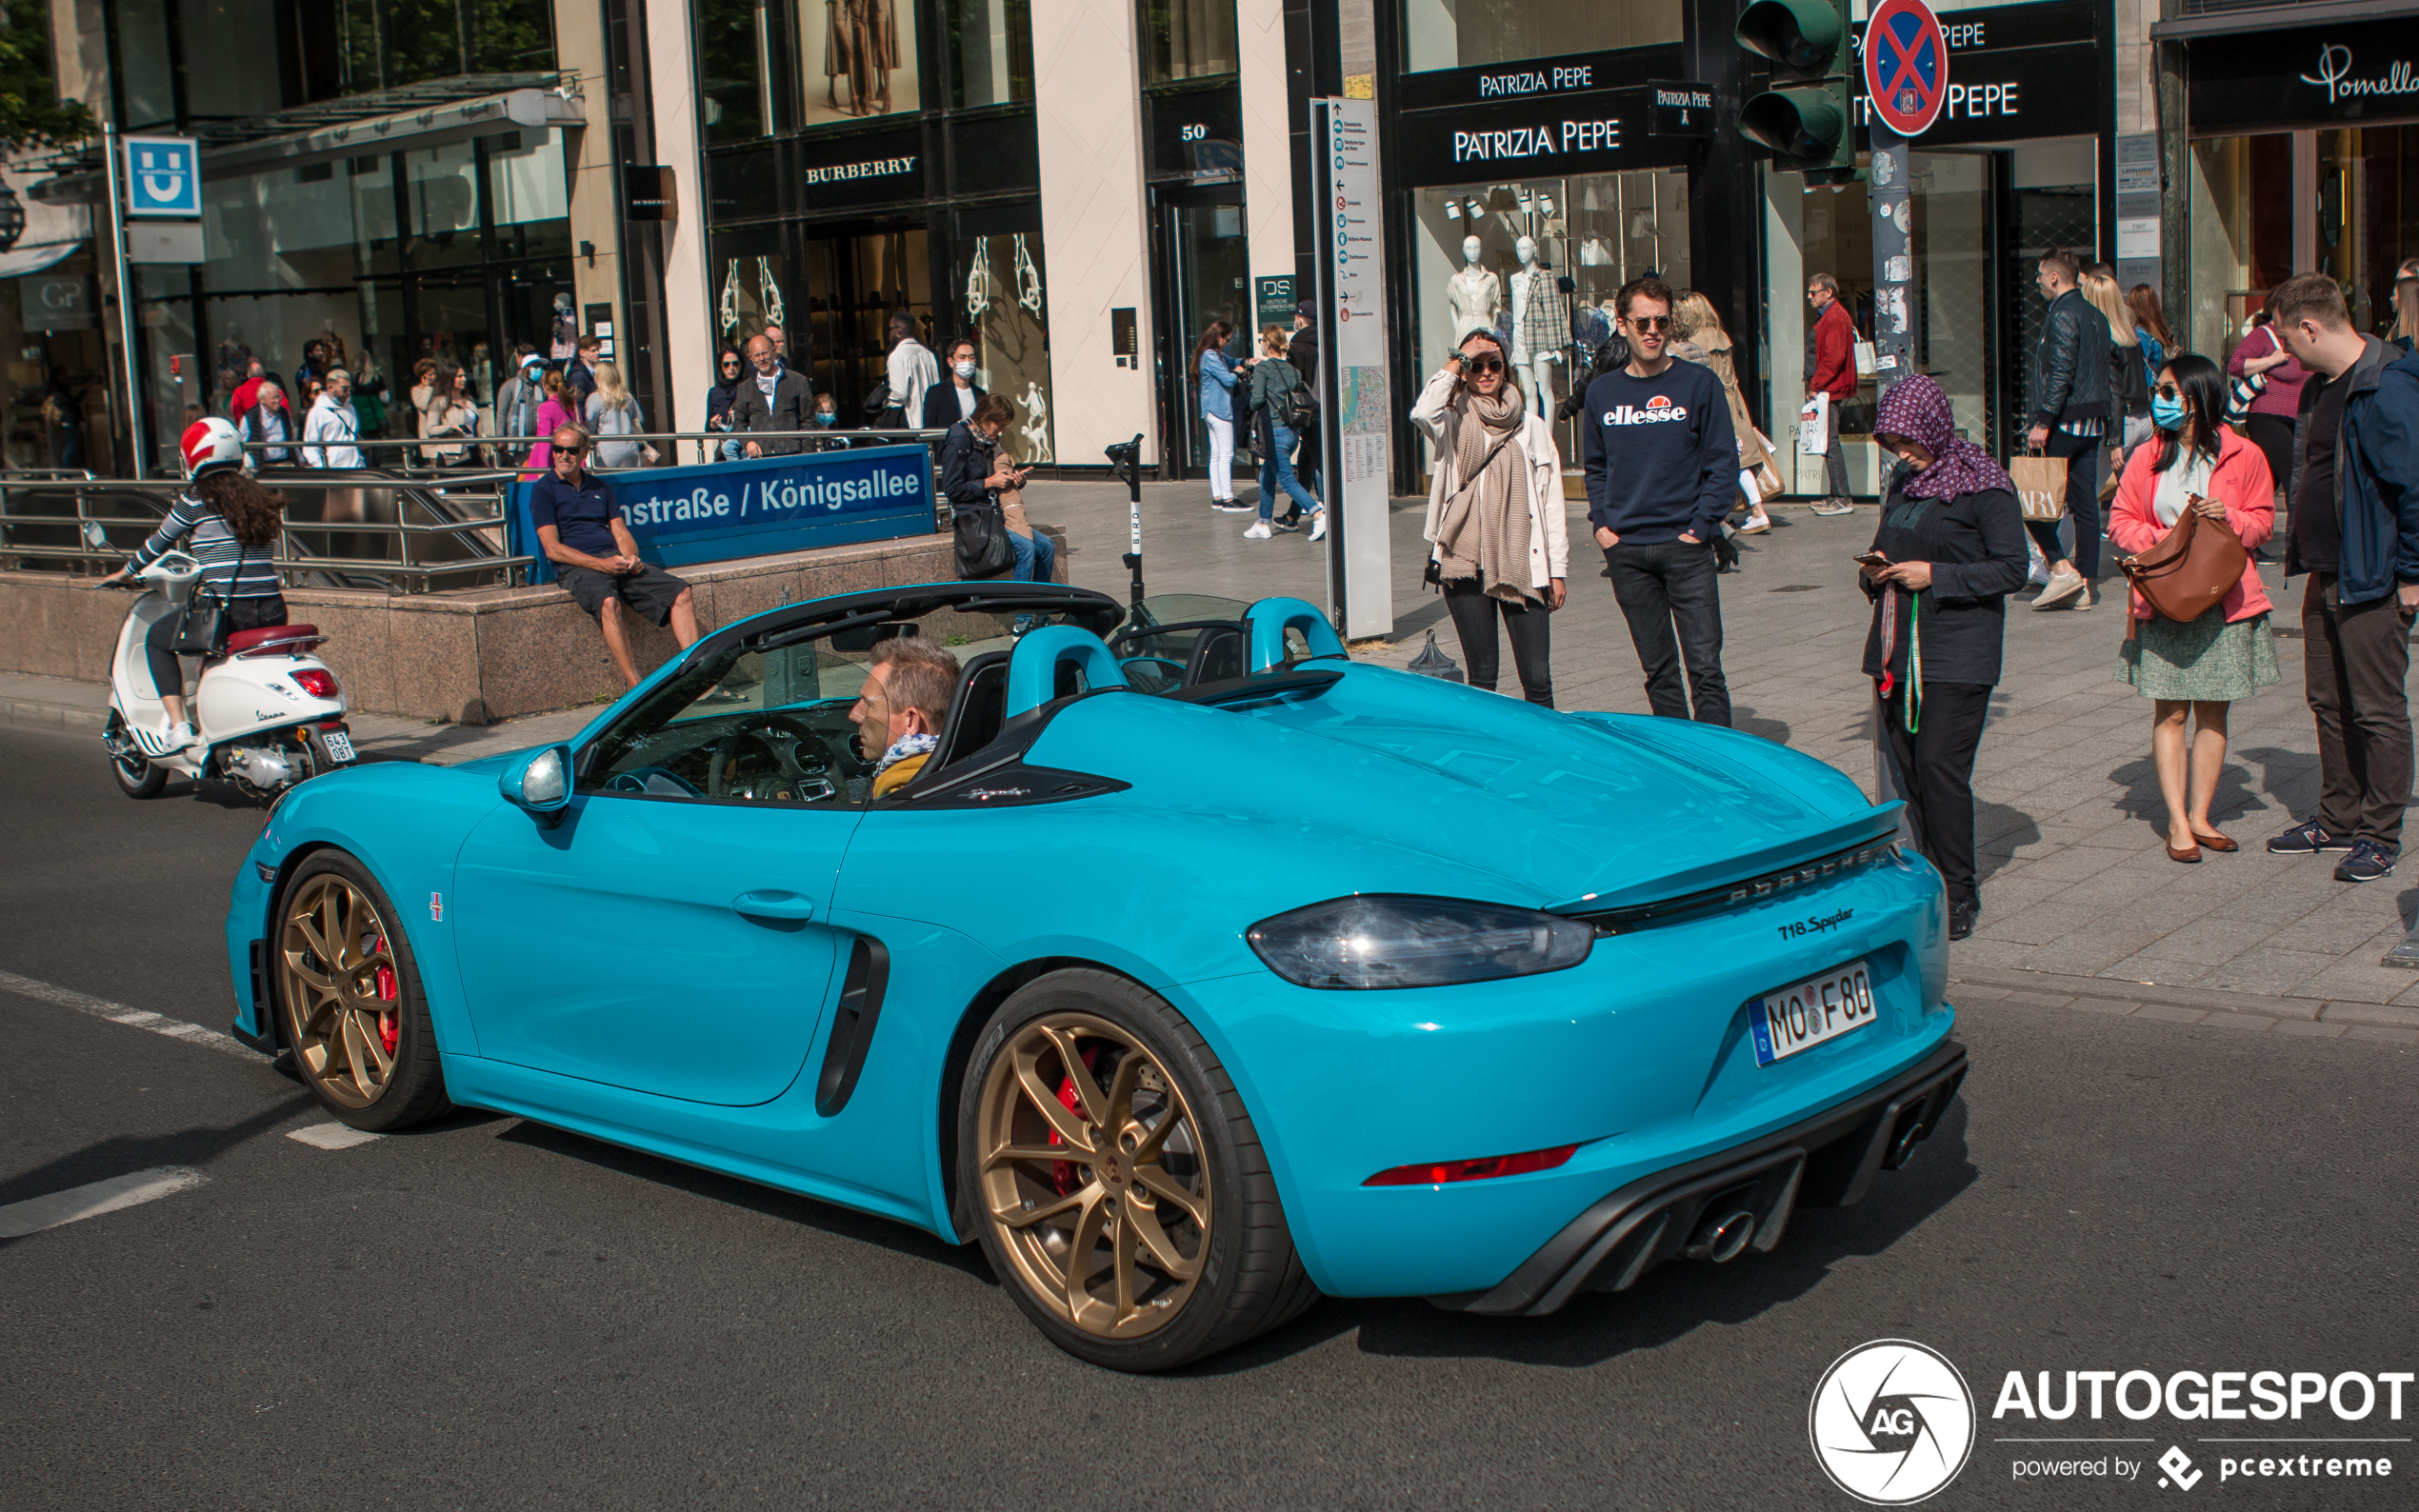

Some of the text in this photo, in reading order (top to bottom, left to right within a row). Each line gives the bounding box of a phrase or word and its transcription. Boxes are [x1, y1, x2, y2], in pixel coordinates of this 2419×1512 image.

[1940, 22, 1985, 47] PEPE
[1480, 65, 1592, 96] PATRIZIA PEPE
[1656, 90, 1711, 108] PATRIZIA PEPE
[1948, 82, 2018, 120] PEPE
[1182, 124, 1207, 142] 50
[1453, 118, 1621, 163] PATRIZIA PEPE
[806, 156, 918, 184] BURBERRY
[1263, 280, 1290, 296] DS
[1603, 405, 1688, 427] ellesse
[761, 468, 920, 510] Königsallee
[1131, 512, 1140, 545] BIRD
[326, 733, 348, 747] 643
[1729, 849, 1870, 905] PORSCHE
[1778, 908, 1855, 941] 718 Spyder
[1767, 969, 1872, 1051] MO F 80
